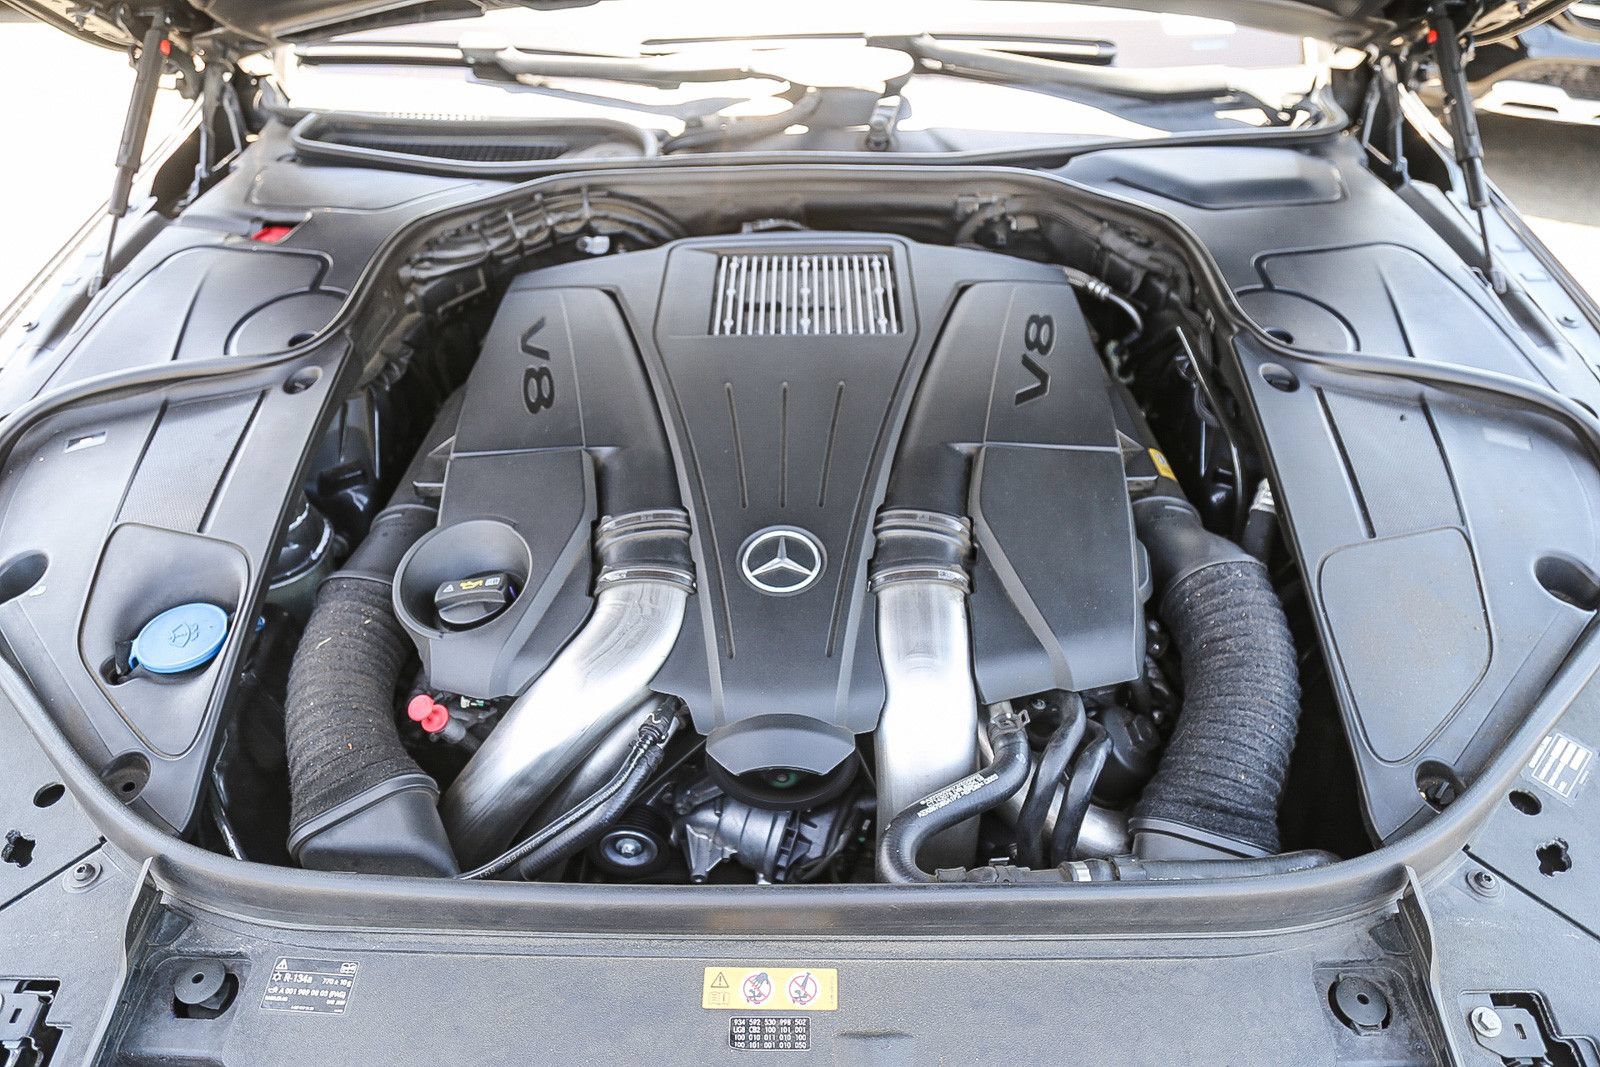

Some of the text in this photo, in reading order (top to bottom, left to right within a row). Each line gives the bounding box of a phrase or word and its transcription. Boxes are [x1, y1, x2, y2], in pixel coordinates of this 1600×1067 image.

[521, 317, 555, 414] V8
[1015, 314, 1055, 405] V8
[283, 973, 313, 984] R-134a
